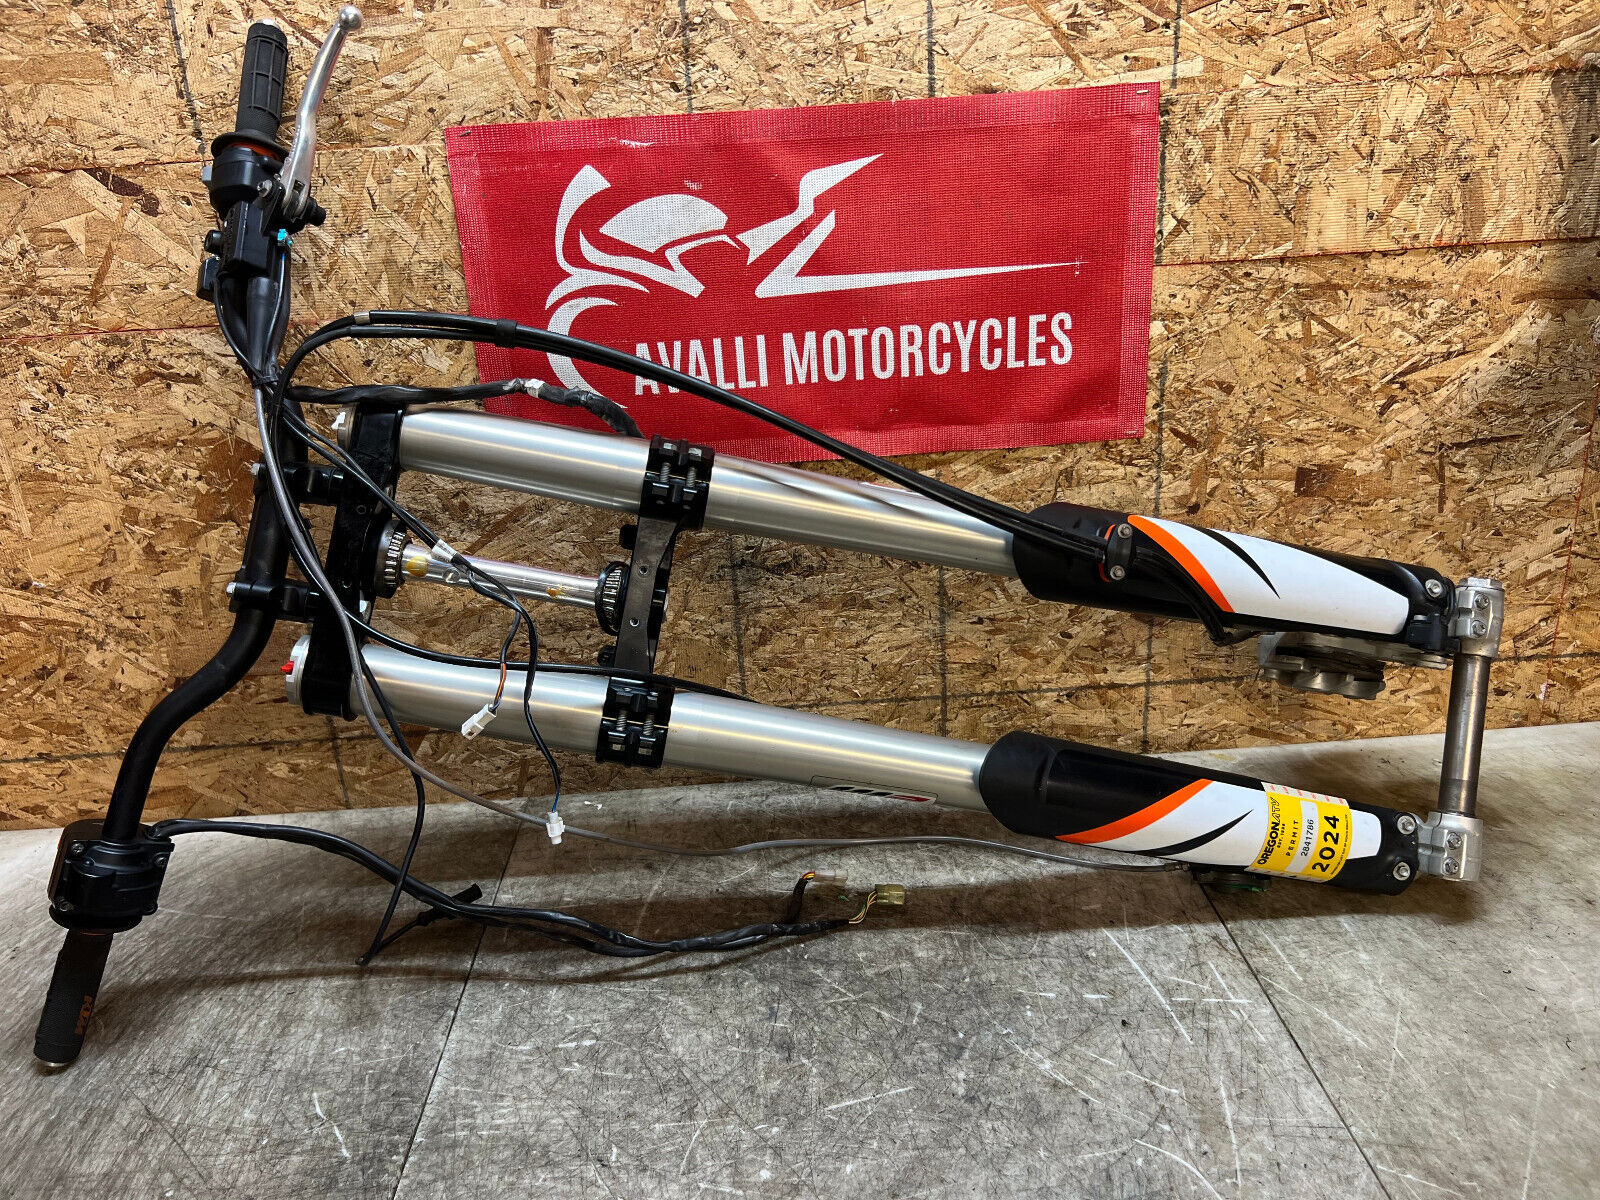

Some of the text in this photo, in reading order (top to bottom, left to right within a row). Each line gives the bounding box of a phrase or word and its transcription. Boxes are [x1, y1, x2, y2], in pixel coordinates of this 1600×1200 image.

[783, 312, 1073, 386] MOTORCYCLES
[1285, 820, 1299, 857] PERMIT
[1300, 819, 1315, 857] 2841786
[1311, 815, 1340, 873] 2024
